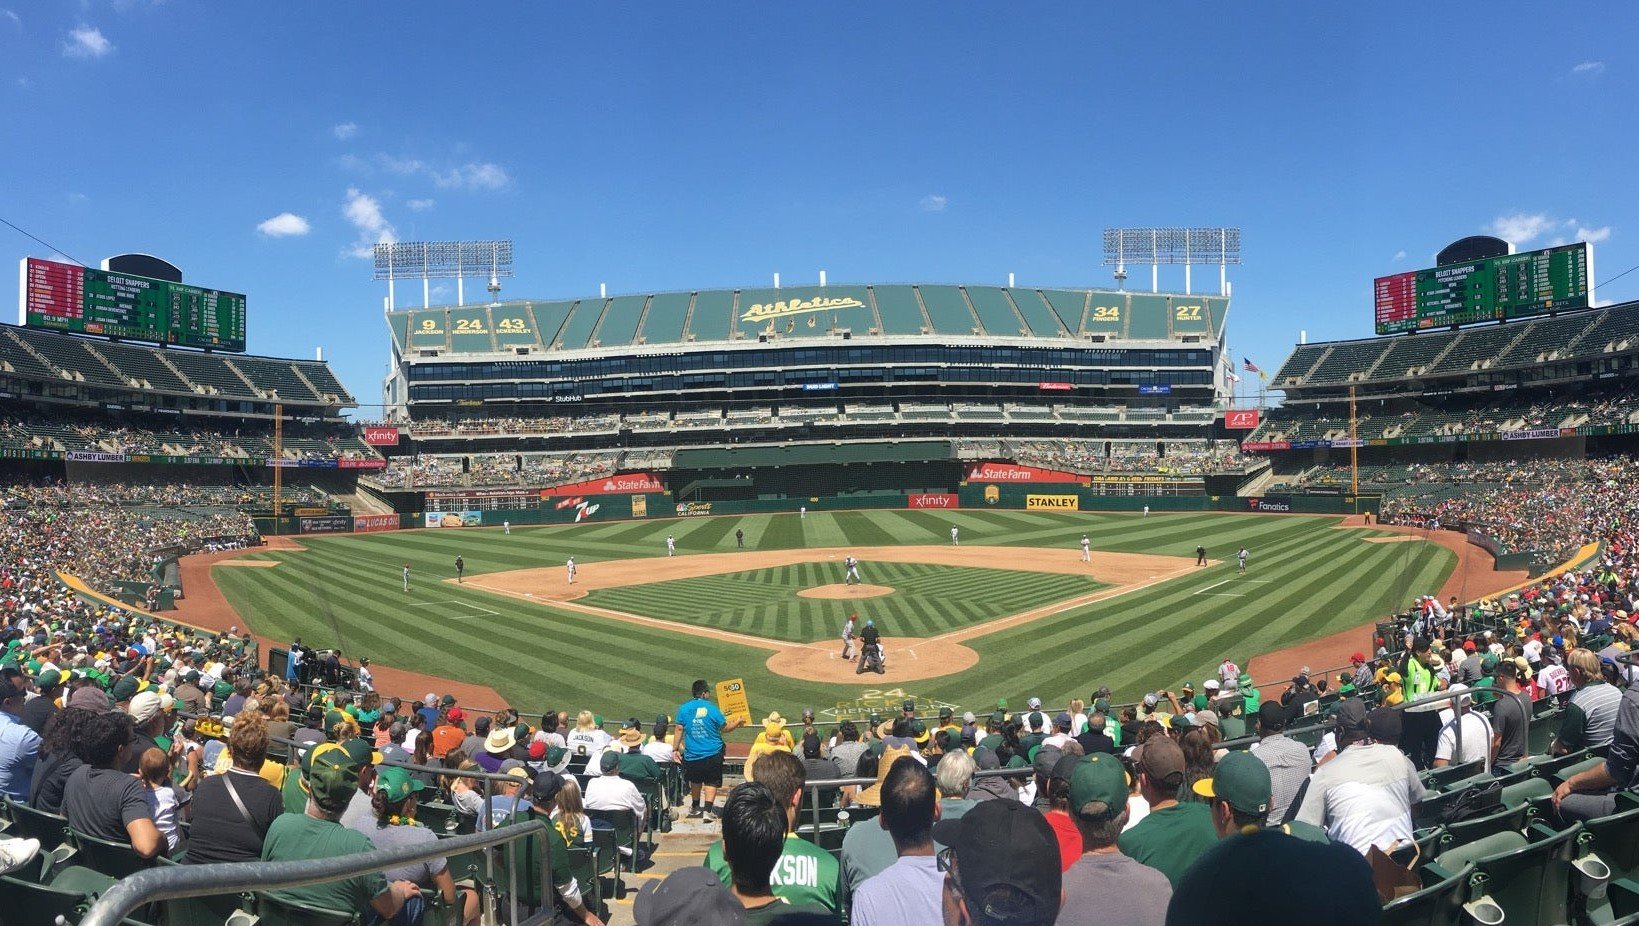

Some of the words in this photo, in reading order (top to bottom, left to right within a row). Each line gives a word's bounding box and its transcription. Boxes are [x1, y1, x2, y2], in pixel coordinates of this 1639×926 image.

[1452, 265, 1475, 275] SNAPPERS
[125, 278, 150, 289] SNAPPERS
[740, 296, 863, 318] Athletics
[1094, 306, 1120, 317] 34
[1176, 305, 1201, 316] 27
[422, 320, 436, 330] 9
[456, 319, 483, 330] 24
[499, 318, 525, 329] 43
[368, 431, 397, 442] xfinity
[1509, 431, 1531, 439] ASHBY
[1532, 429, 1559, 438] LUMBER
[97, 454, 124, 462] LUMBER
[984, 468, 1008, 480] State
[1008, 469, 1031, 480] Farm
[617, 480, 639, 490] State
[640, 479, 660, 489] Farm
[916, 494, 950, 507] xfinity
[1028, 497, 1076, 507] STANLEY
[1259, 501, 1289, 511] Fanatics
[366, 518, 387, 527] LUCAS
[388, 517, 398, 526] OIL
[863, 688, 907, 699] 24
[835, 703, 941, 715] HENDERON
[573, 734, 594, 743] JACKSON
